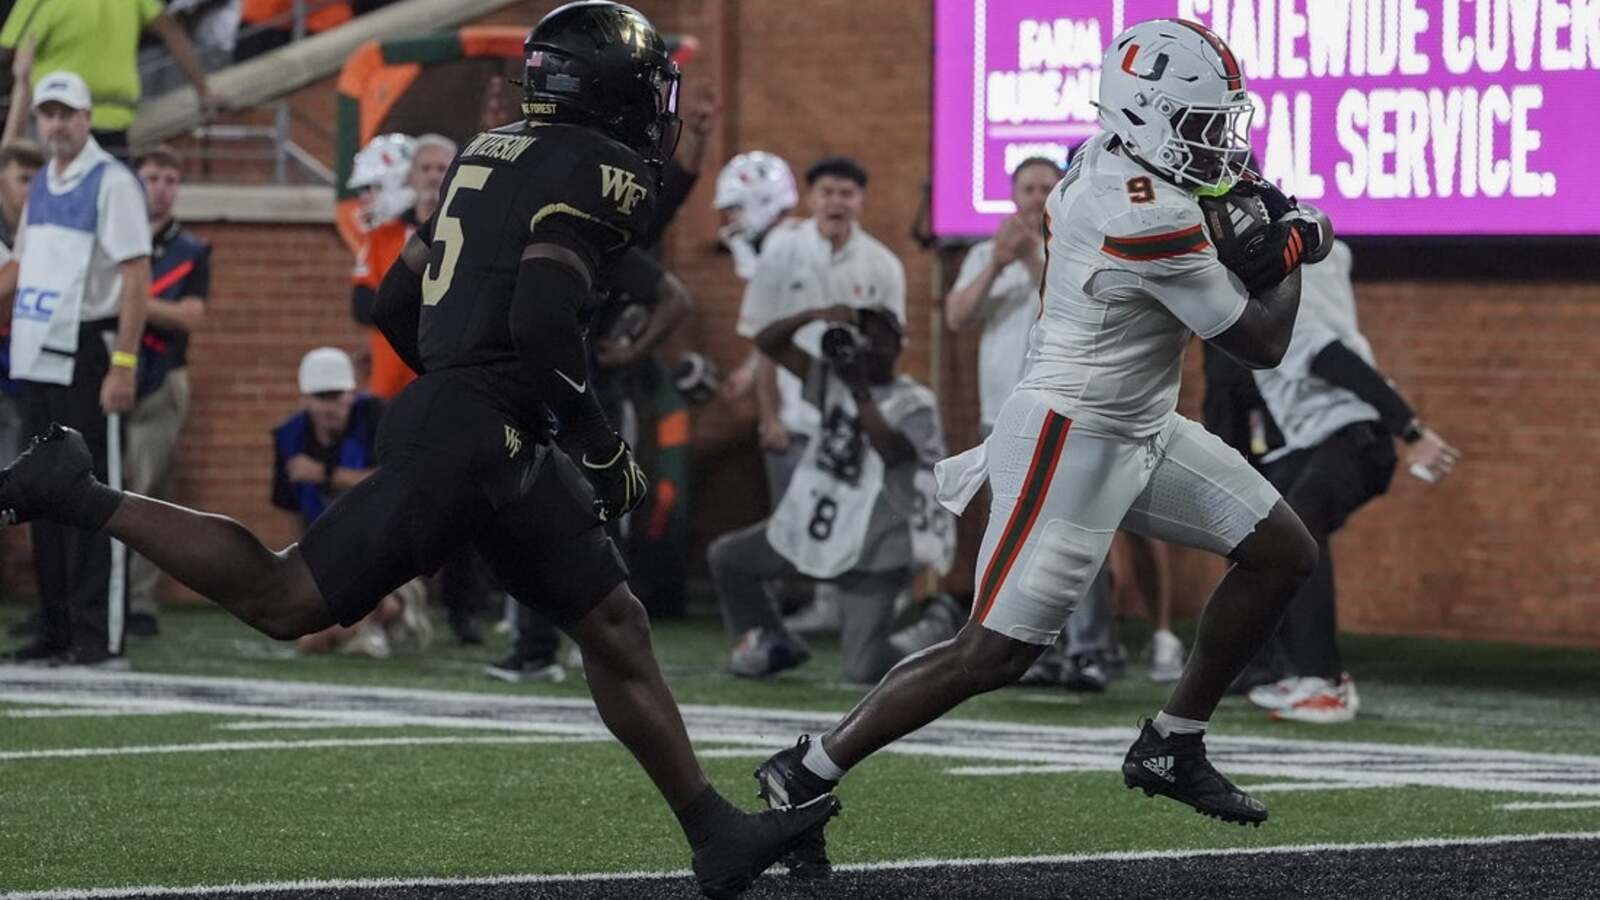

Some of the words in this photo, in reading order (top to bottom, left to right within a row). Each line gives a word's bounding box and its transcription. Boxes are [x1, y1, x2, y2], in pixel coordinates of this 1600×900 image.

[1121, 44, 1170, 81] U
[1177, 0, 1430, 80] ATEWIDE
[1335, 85, 1557, 199] SERVICE.
[600, 164, 648, 216] WF
[1126, 176, 1156, 204] 9
[421, 164, 494, 307] 5
[16, 286, 61, 316] CC
[808, 497, 838, 541] 8
